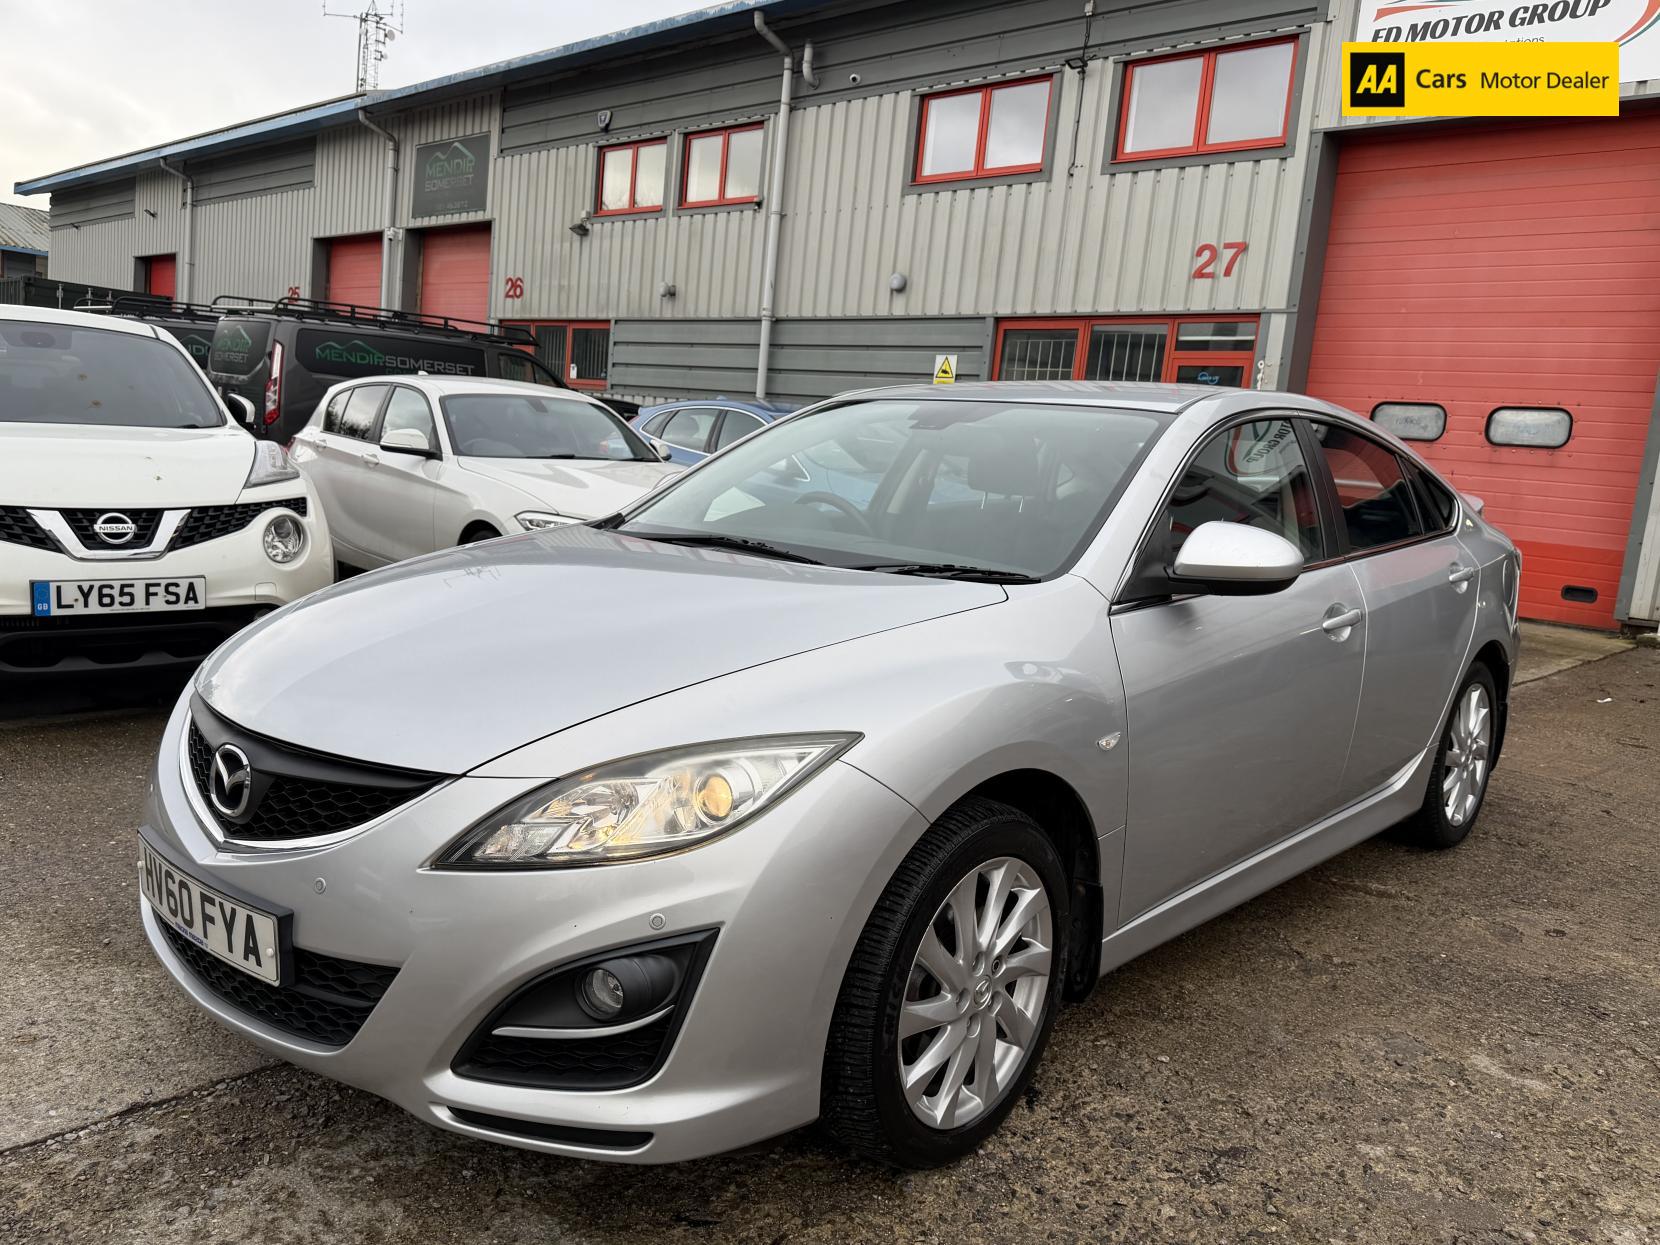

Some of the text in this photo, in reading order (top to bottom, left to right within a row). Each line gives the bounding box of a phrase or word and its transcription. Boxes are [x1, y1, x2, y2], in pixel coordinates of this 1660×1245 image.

[1404, 10, 1505, 42] MOTOR
[1508, 0, 1612, 28] GROUP
[1192, 241, 1248, 279] 27
[505, 277, 524, 299] 26
[37, 602, 49, 611] GB
[56, 581, 199, 609] LY65 FSA
[144, 846, 263, 969] HV60 FYA
